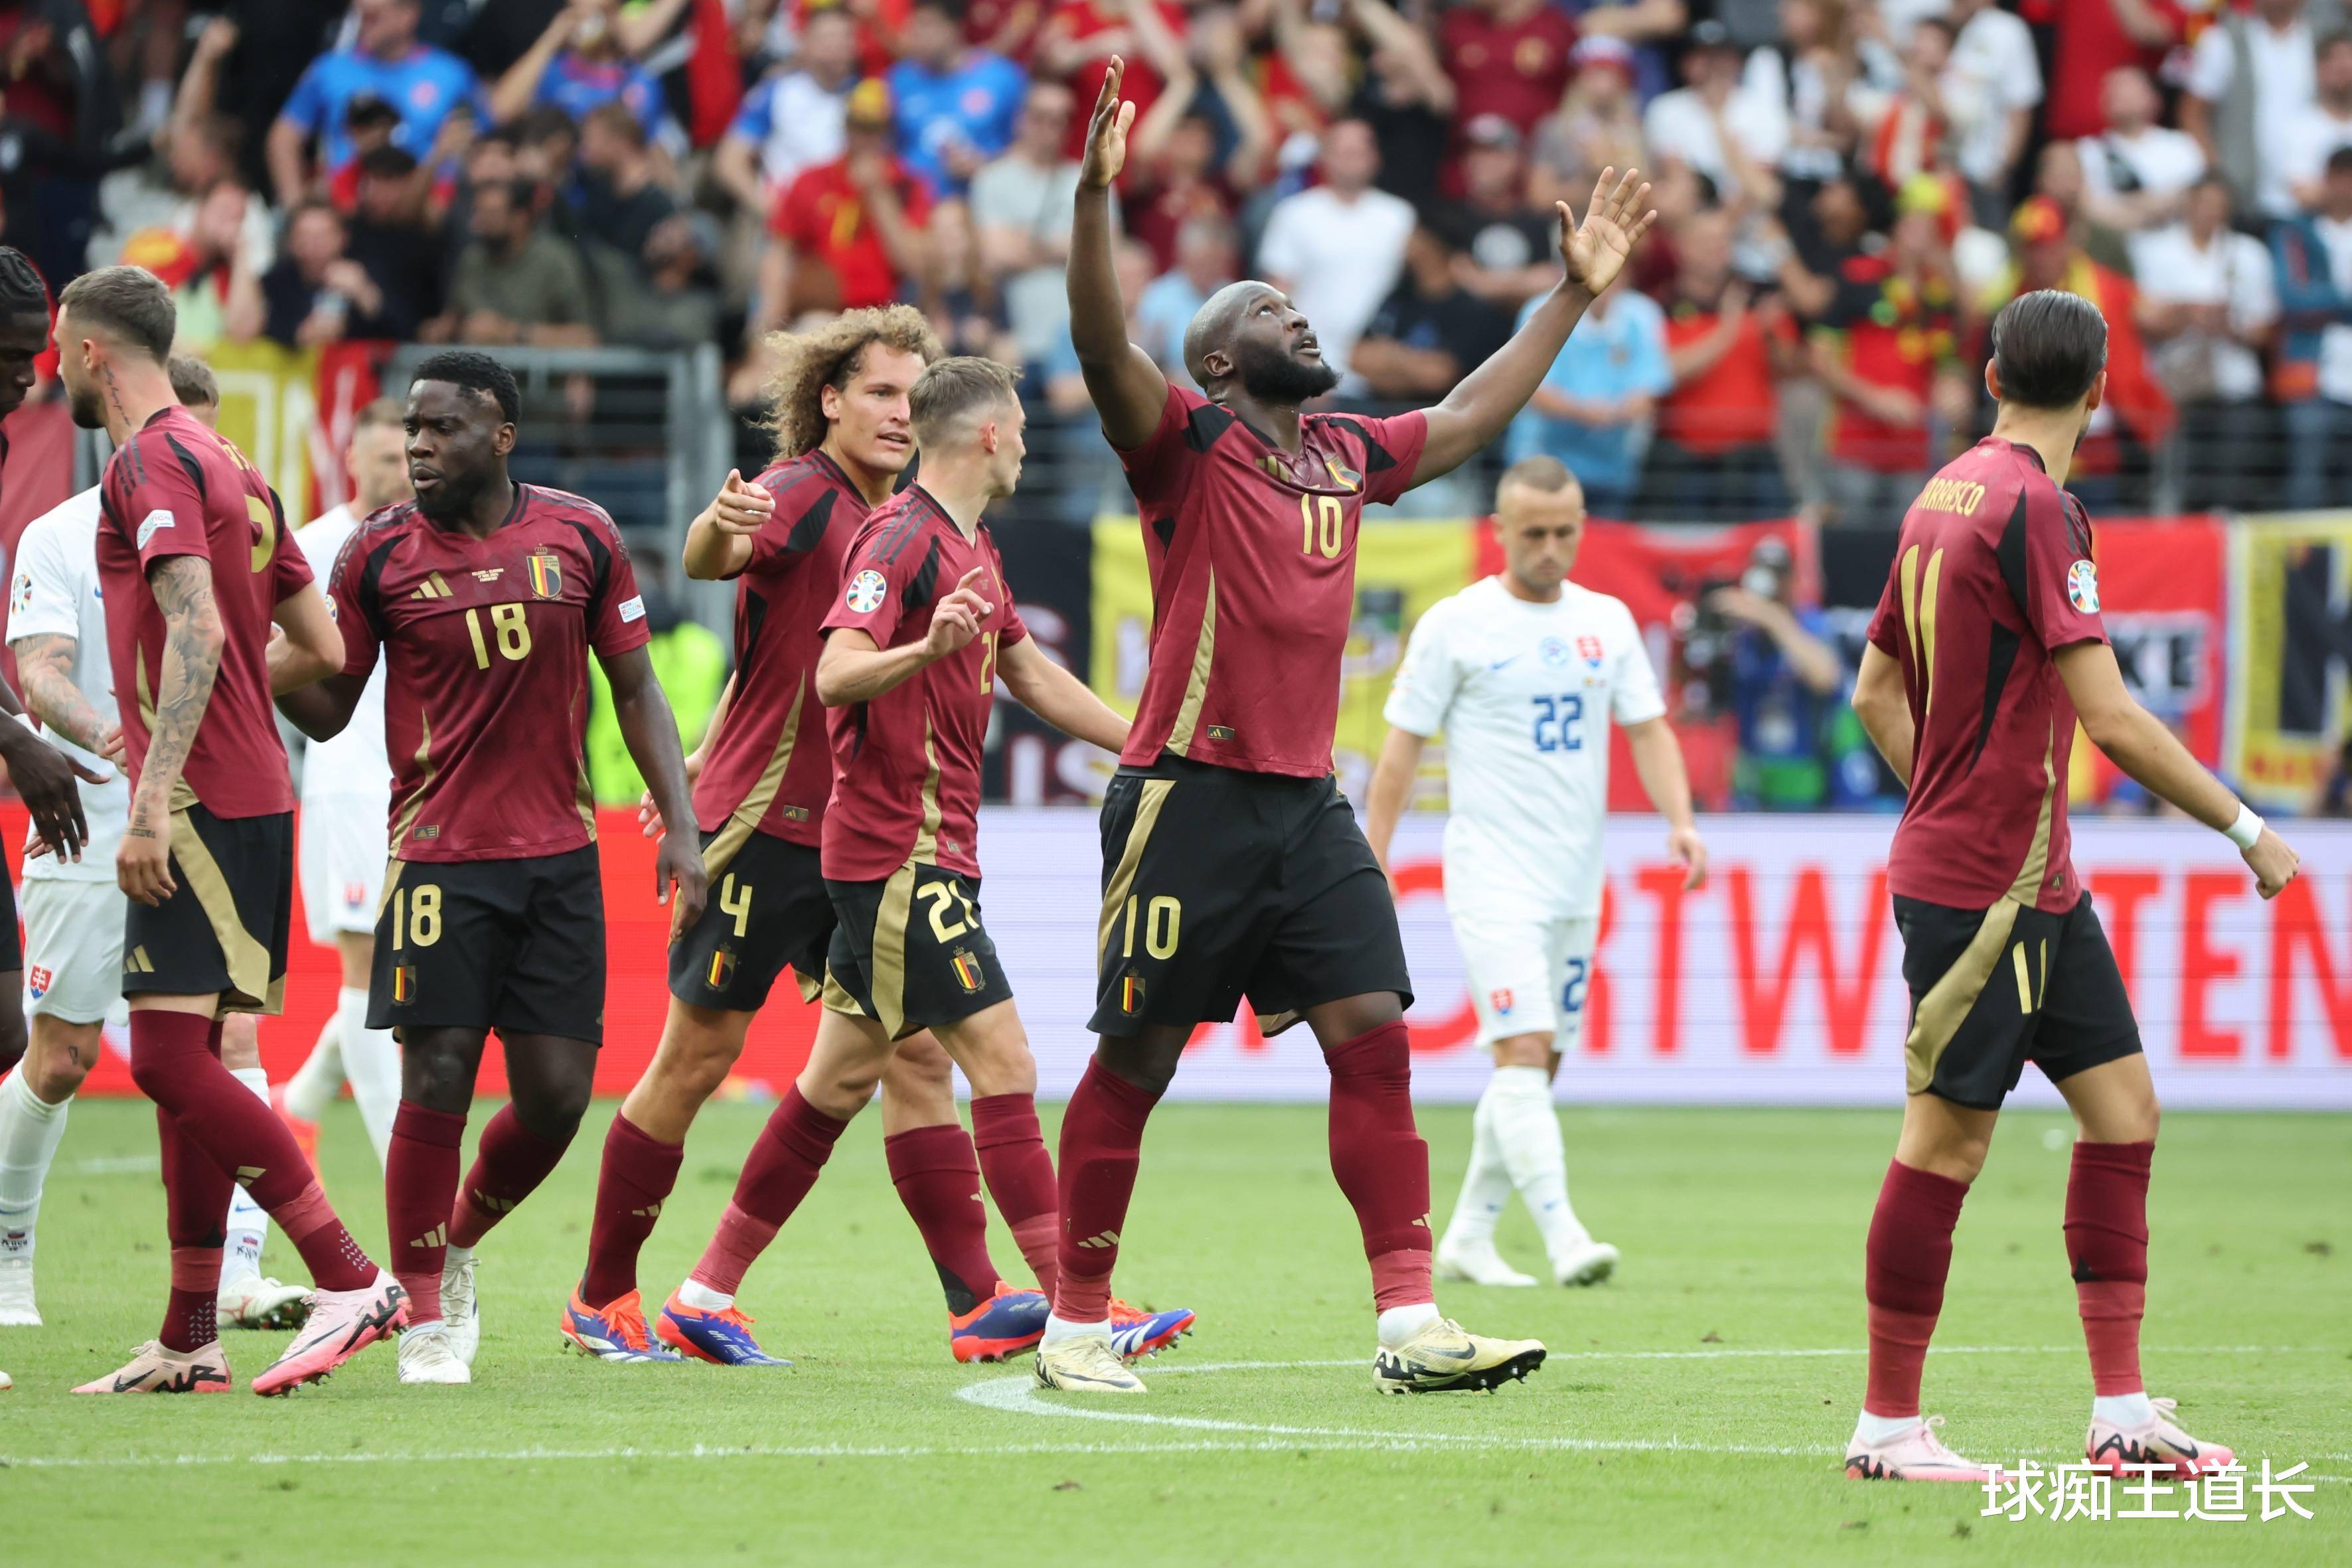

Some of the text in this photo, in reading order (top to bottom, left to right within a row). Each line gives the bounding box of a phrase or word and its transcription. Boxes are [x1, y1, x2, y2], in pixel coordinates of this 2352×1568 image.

[1301, 493, 1342, 558] 10
[1916, 477, 1986, 517] ARRASCO
[465, 602, 532, 670] 18
[1901, 544, 1943, 716] 11
[1532, 694, 1583, 751] 22
[393, 884, 441, 951] 18
[720, 872, 753, 937] 4
[1123, 894, 1181, 960] 10
[1563, 956, 1591, 1014] 2
[2013, 937, 2047, 1014] 11
